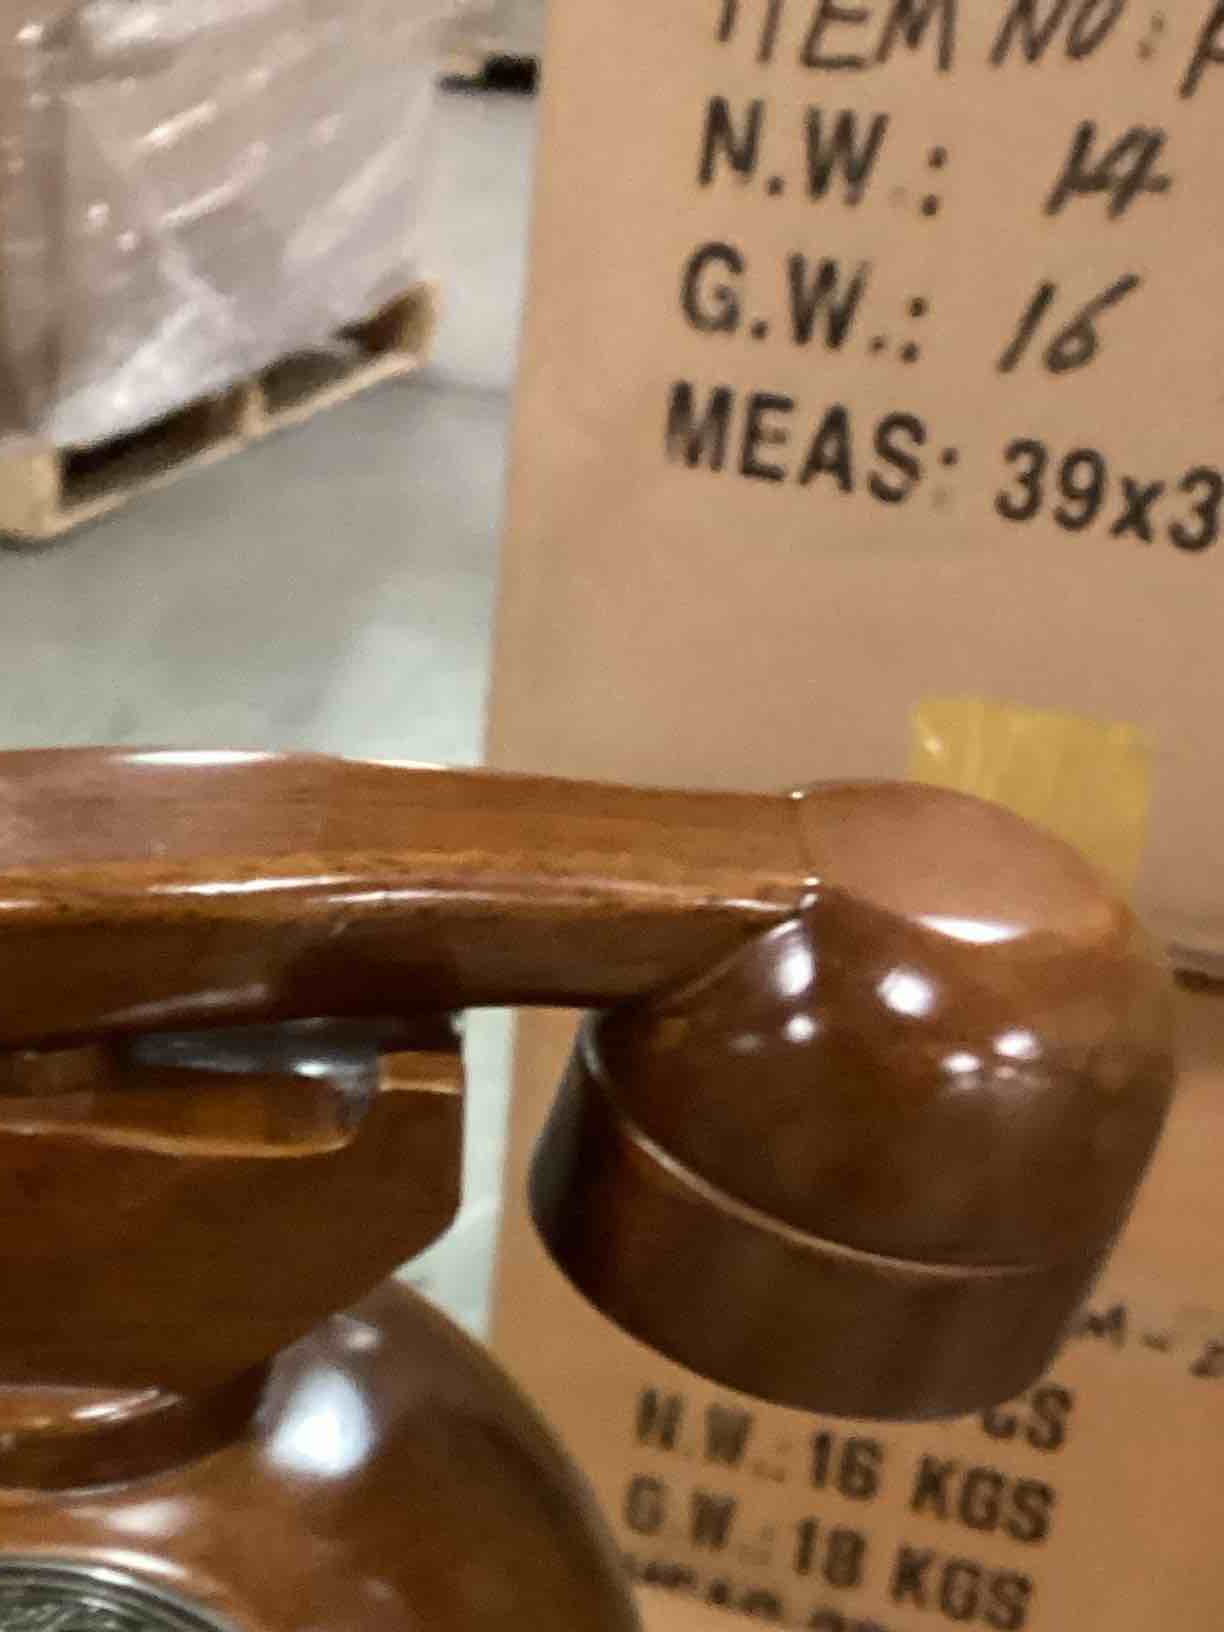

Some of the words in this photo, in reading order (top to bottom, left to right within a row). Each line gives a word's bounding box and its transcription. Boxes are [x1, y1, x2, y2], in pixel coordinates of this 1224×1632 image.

[1044, 119, 1172, 219] 14
[995, 273, 1141, 374] 16
[811, 1428, 883, 1501] 16
[910, 1453, 1055, 1544] KGS
